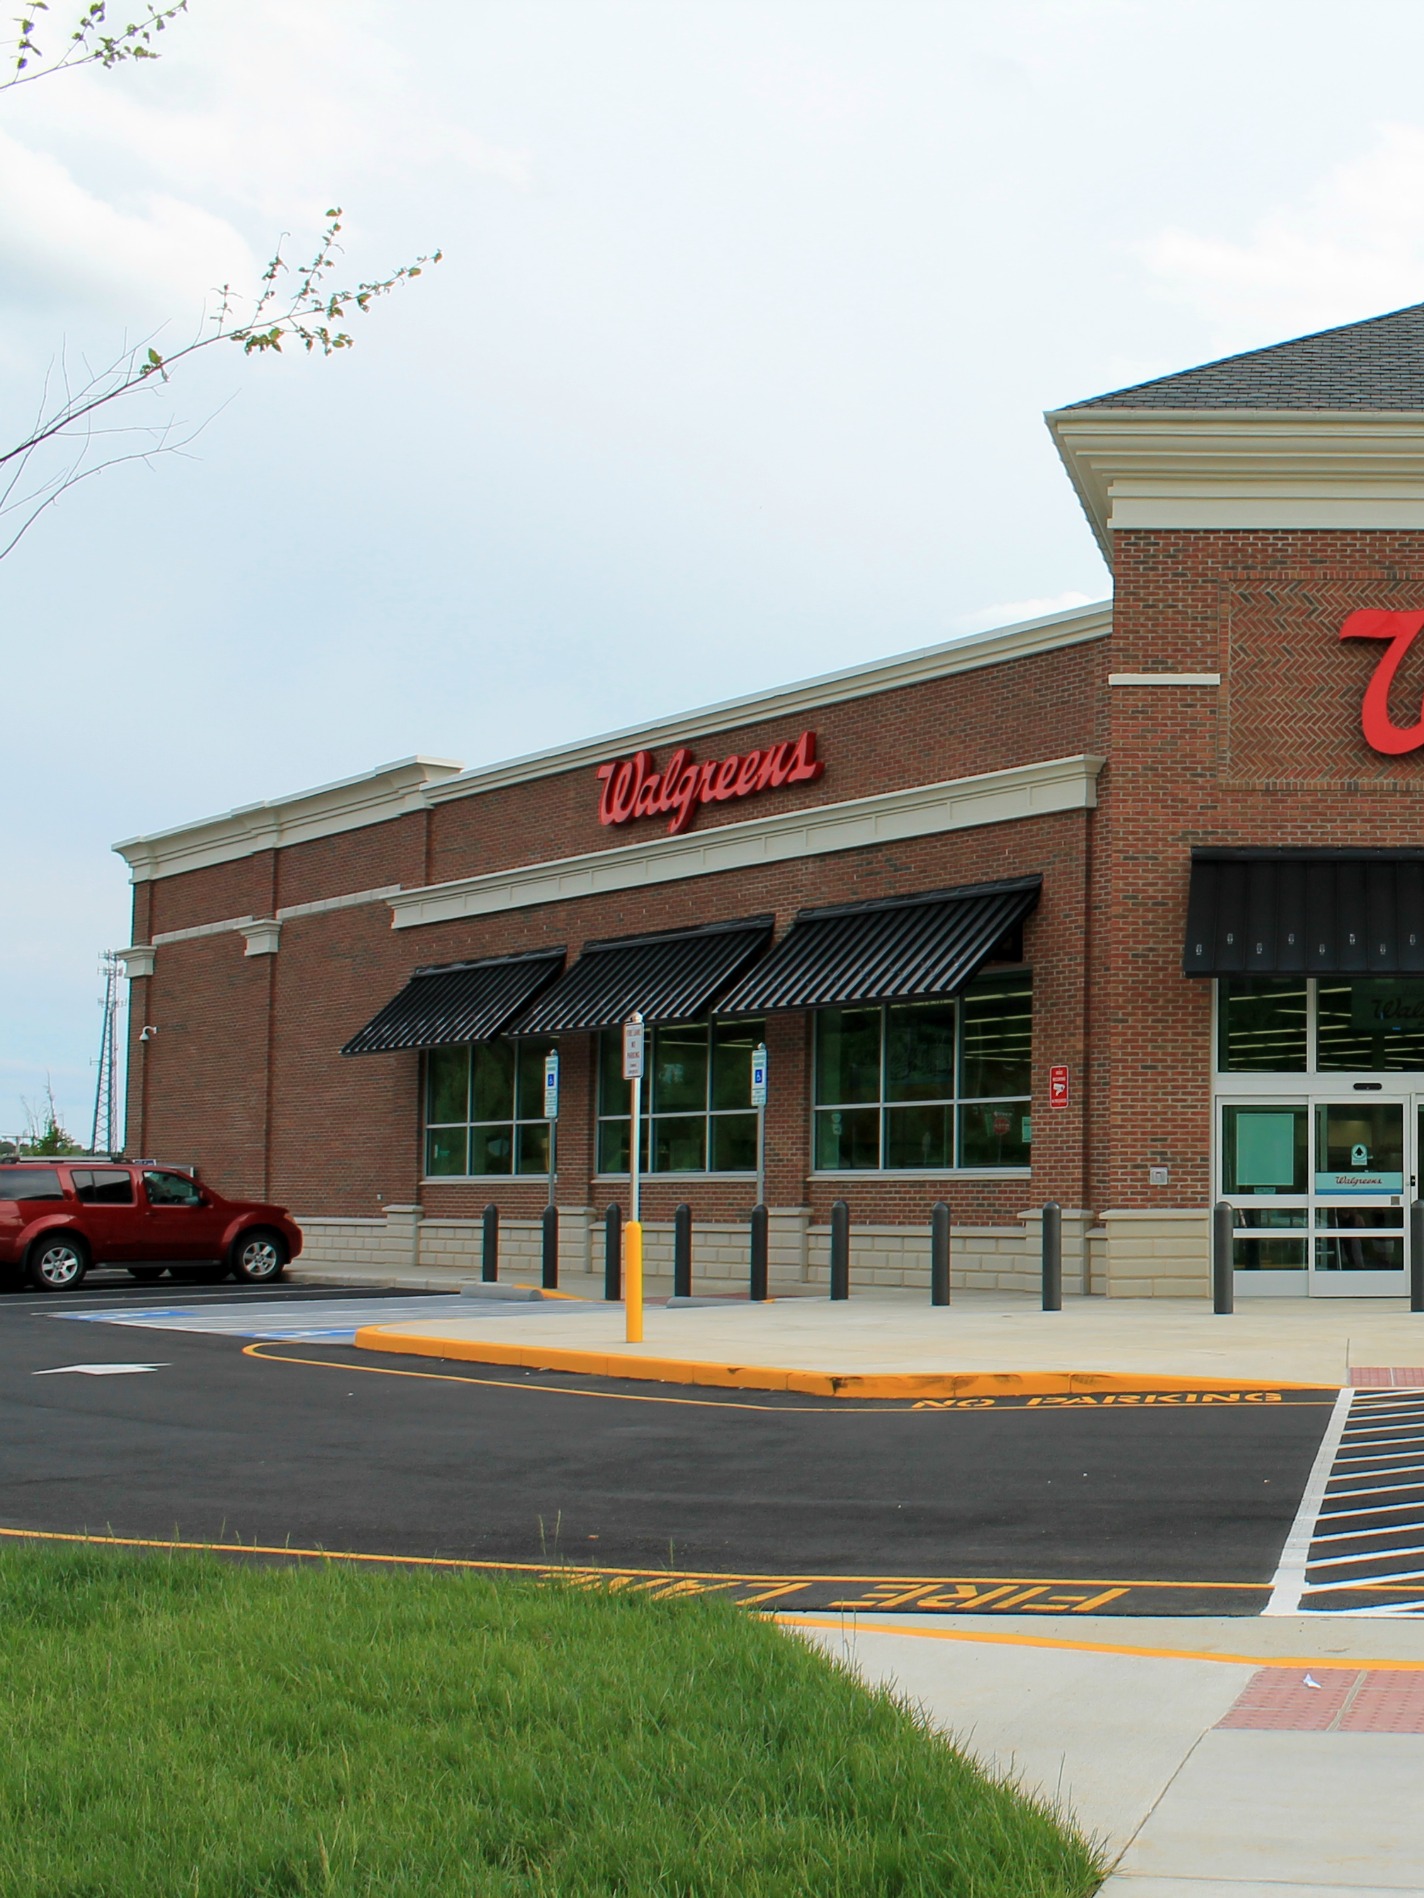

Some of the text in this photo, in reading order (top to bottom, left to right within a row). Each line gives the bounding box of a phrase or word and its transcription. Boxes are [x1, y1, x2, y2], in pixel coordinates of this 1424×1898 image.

[596, 730, 826, 834] Walgreens
[1335, 1175, 1383, 1186] Walgreens
[911, 1392, 1282, 1409] NO PARKING
[828, 1584, 1131, 1612] FIRE
